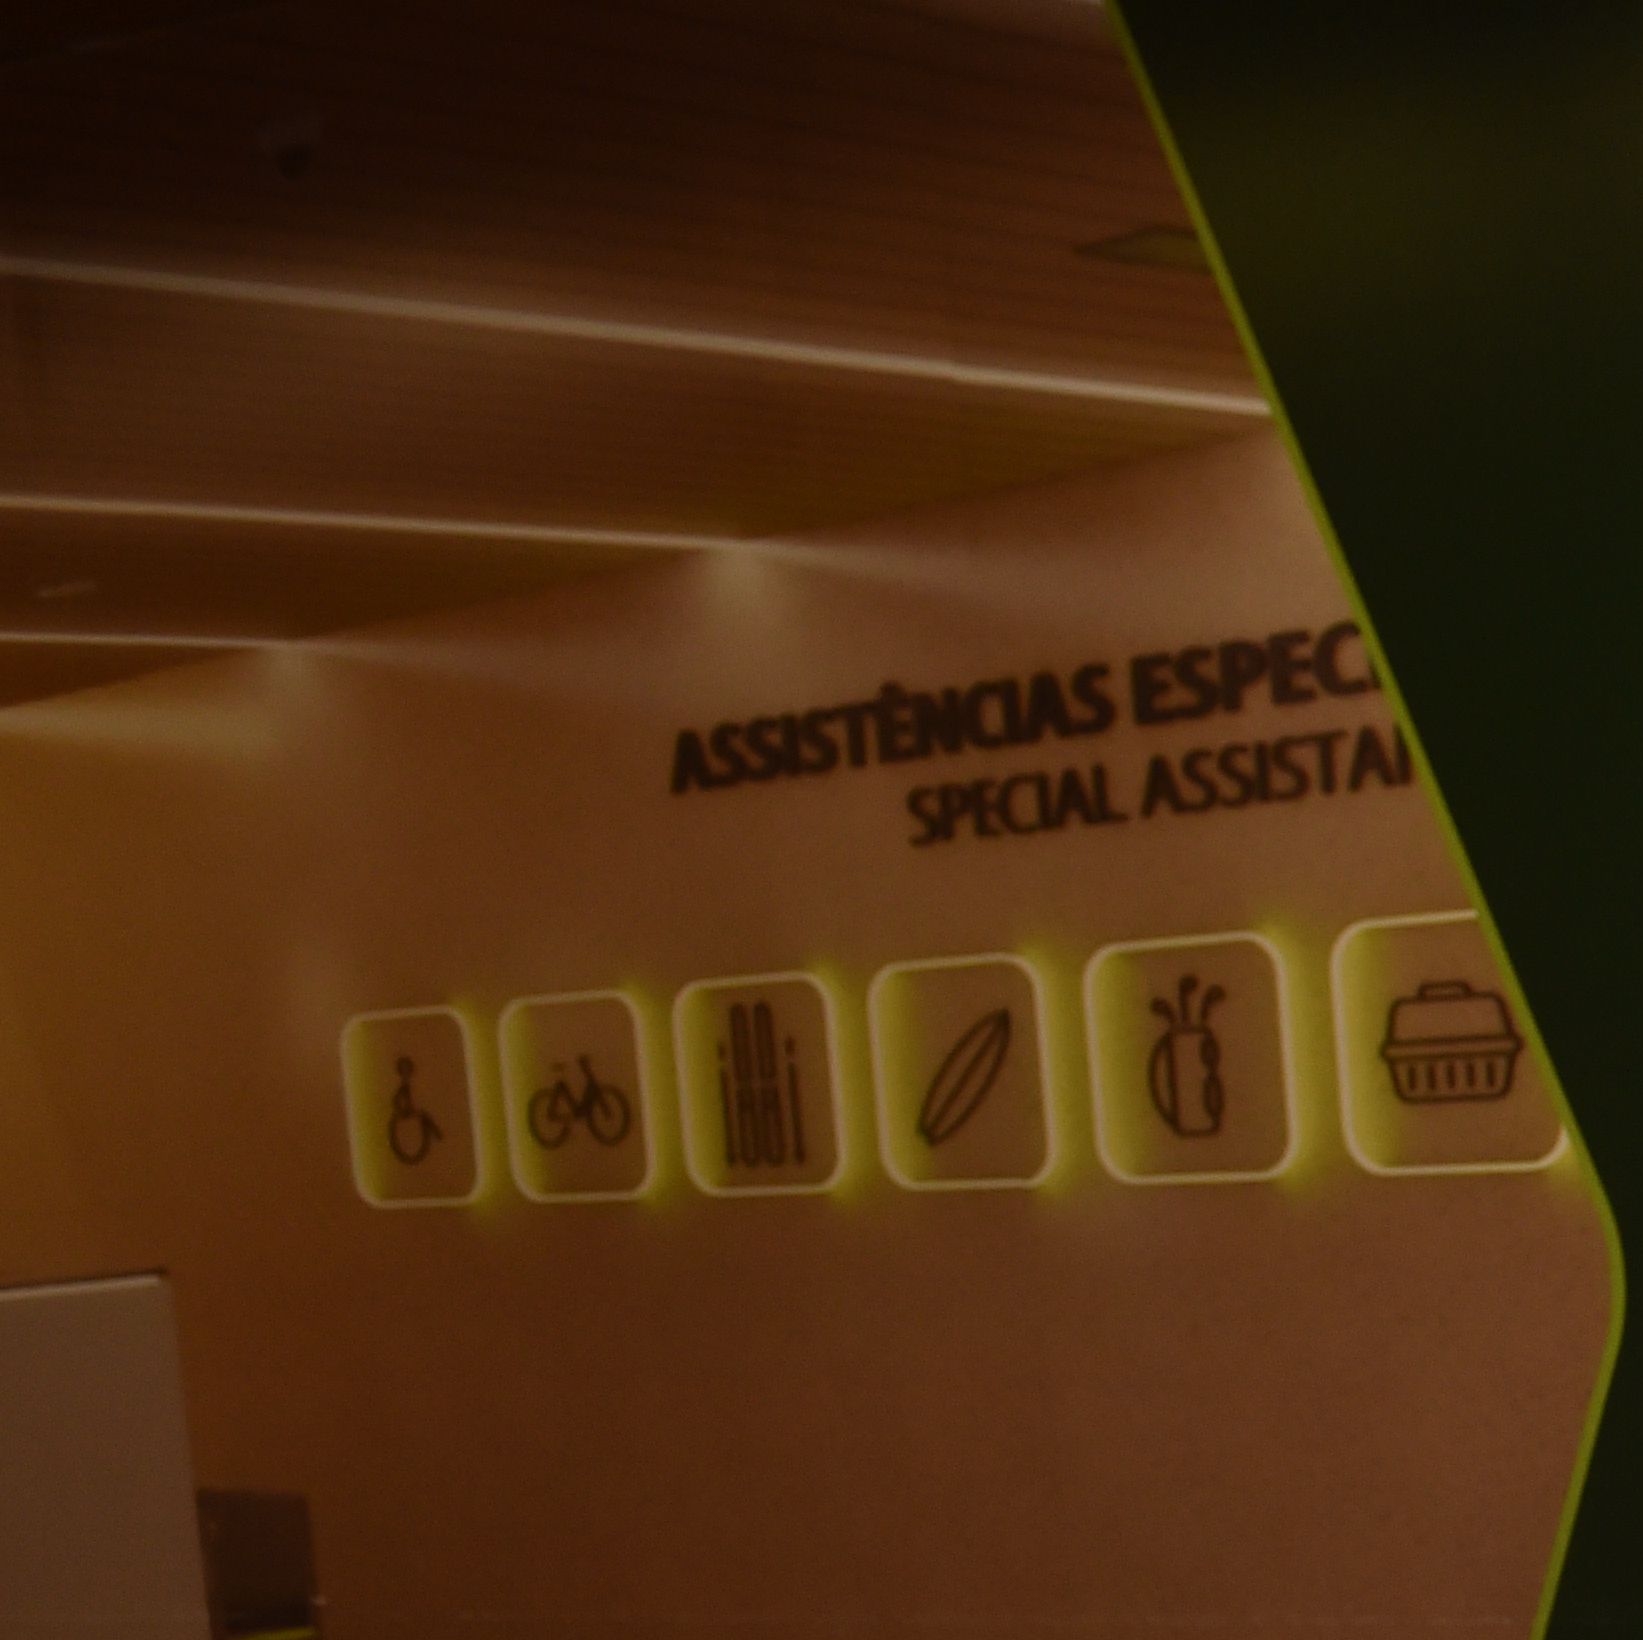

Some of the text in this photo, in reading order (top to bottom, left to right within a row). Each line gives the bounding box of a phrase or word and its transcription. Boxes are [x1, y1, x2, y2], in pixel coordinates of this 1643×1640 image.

[670, 619, 1383, 795] ASSISTÊNCIAS ESPEC
[906, 764, 1129, 847] SPECIAL
